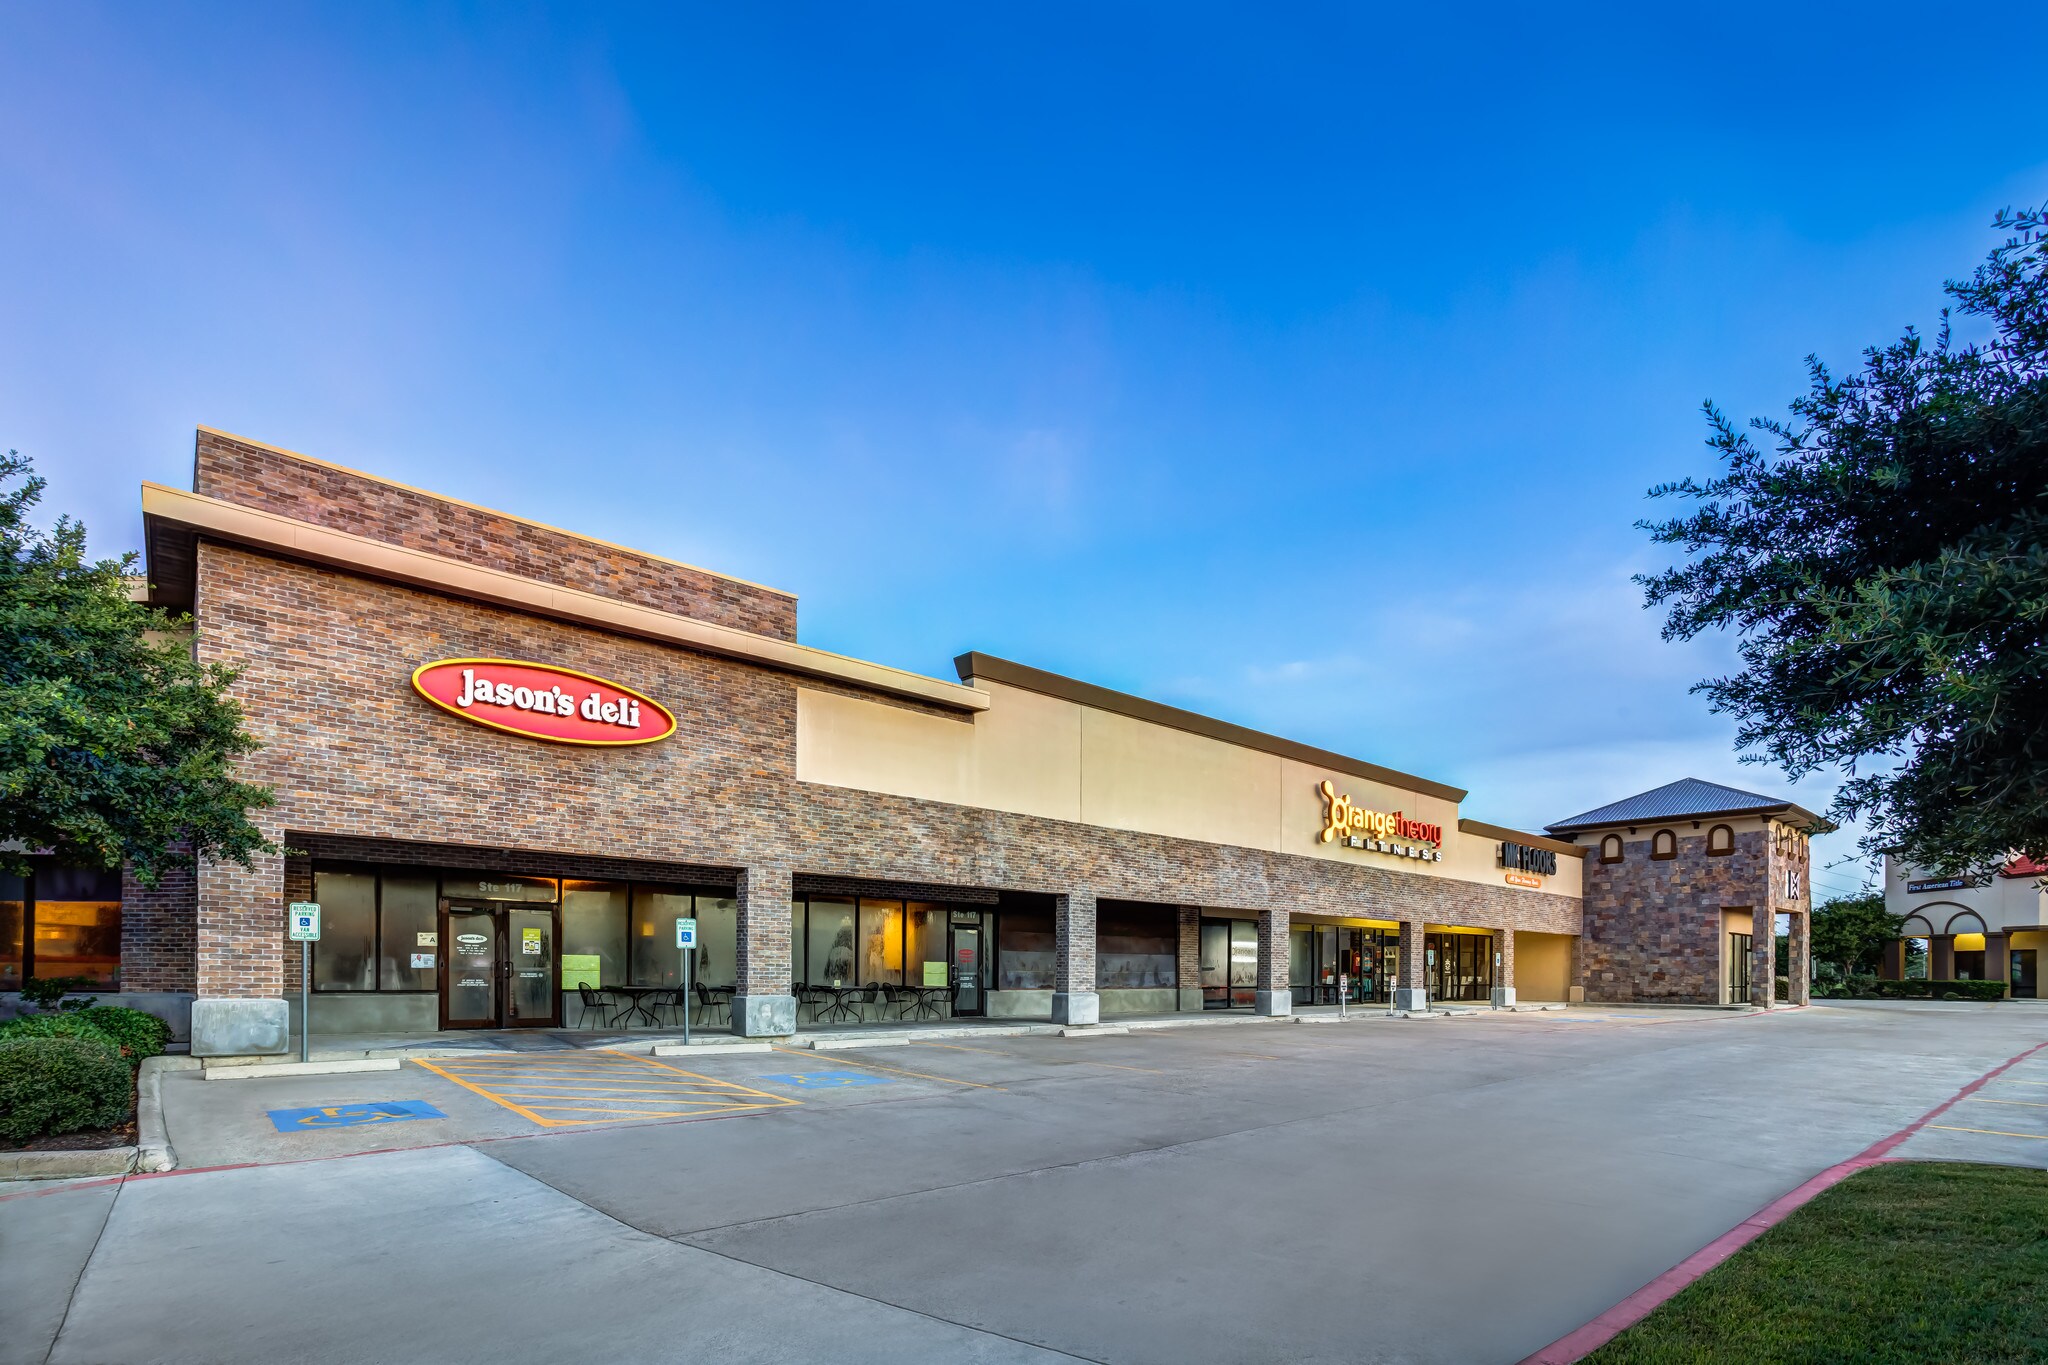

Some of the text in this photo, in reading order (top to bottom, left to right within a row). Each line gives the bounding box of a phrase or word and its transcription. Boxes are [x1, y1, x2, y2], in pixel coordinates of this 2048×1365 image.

[456, 669, 641, 729] Jason's deli
[1348, 835, 1443, 862] FITNESS
[1503, 842, 1557, 876] MK FLOORS
[478, 881, 523, 893] Ste 117
[1922, 881, 1949, 889] American
[1949, 879, 1963, 887] Title
[952, 910, 977, 919] Ste 117
